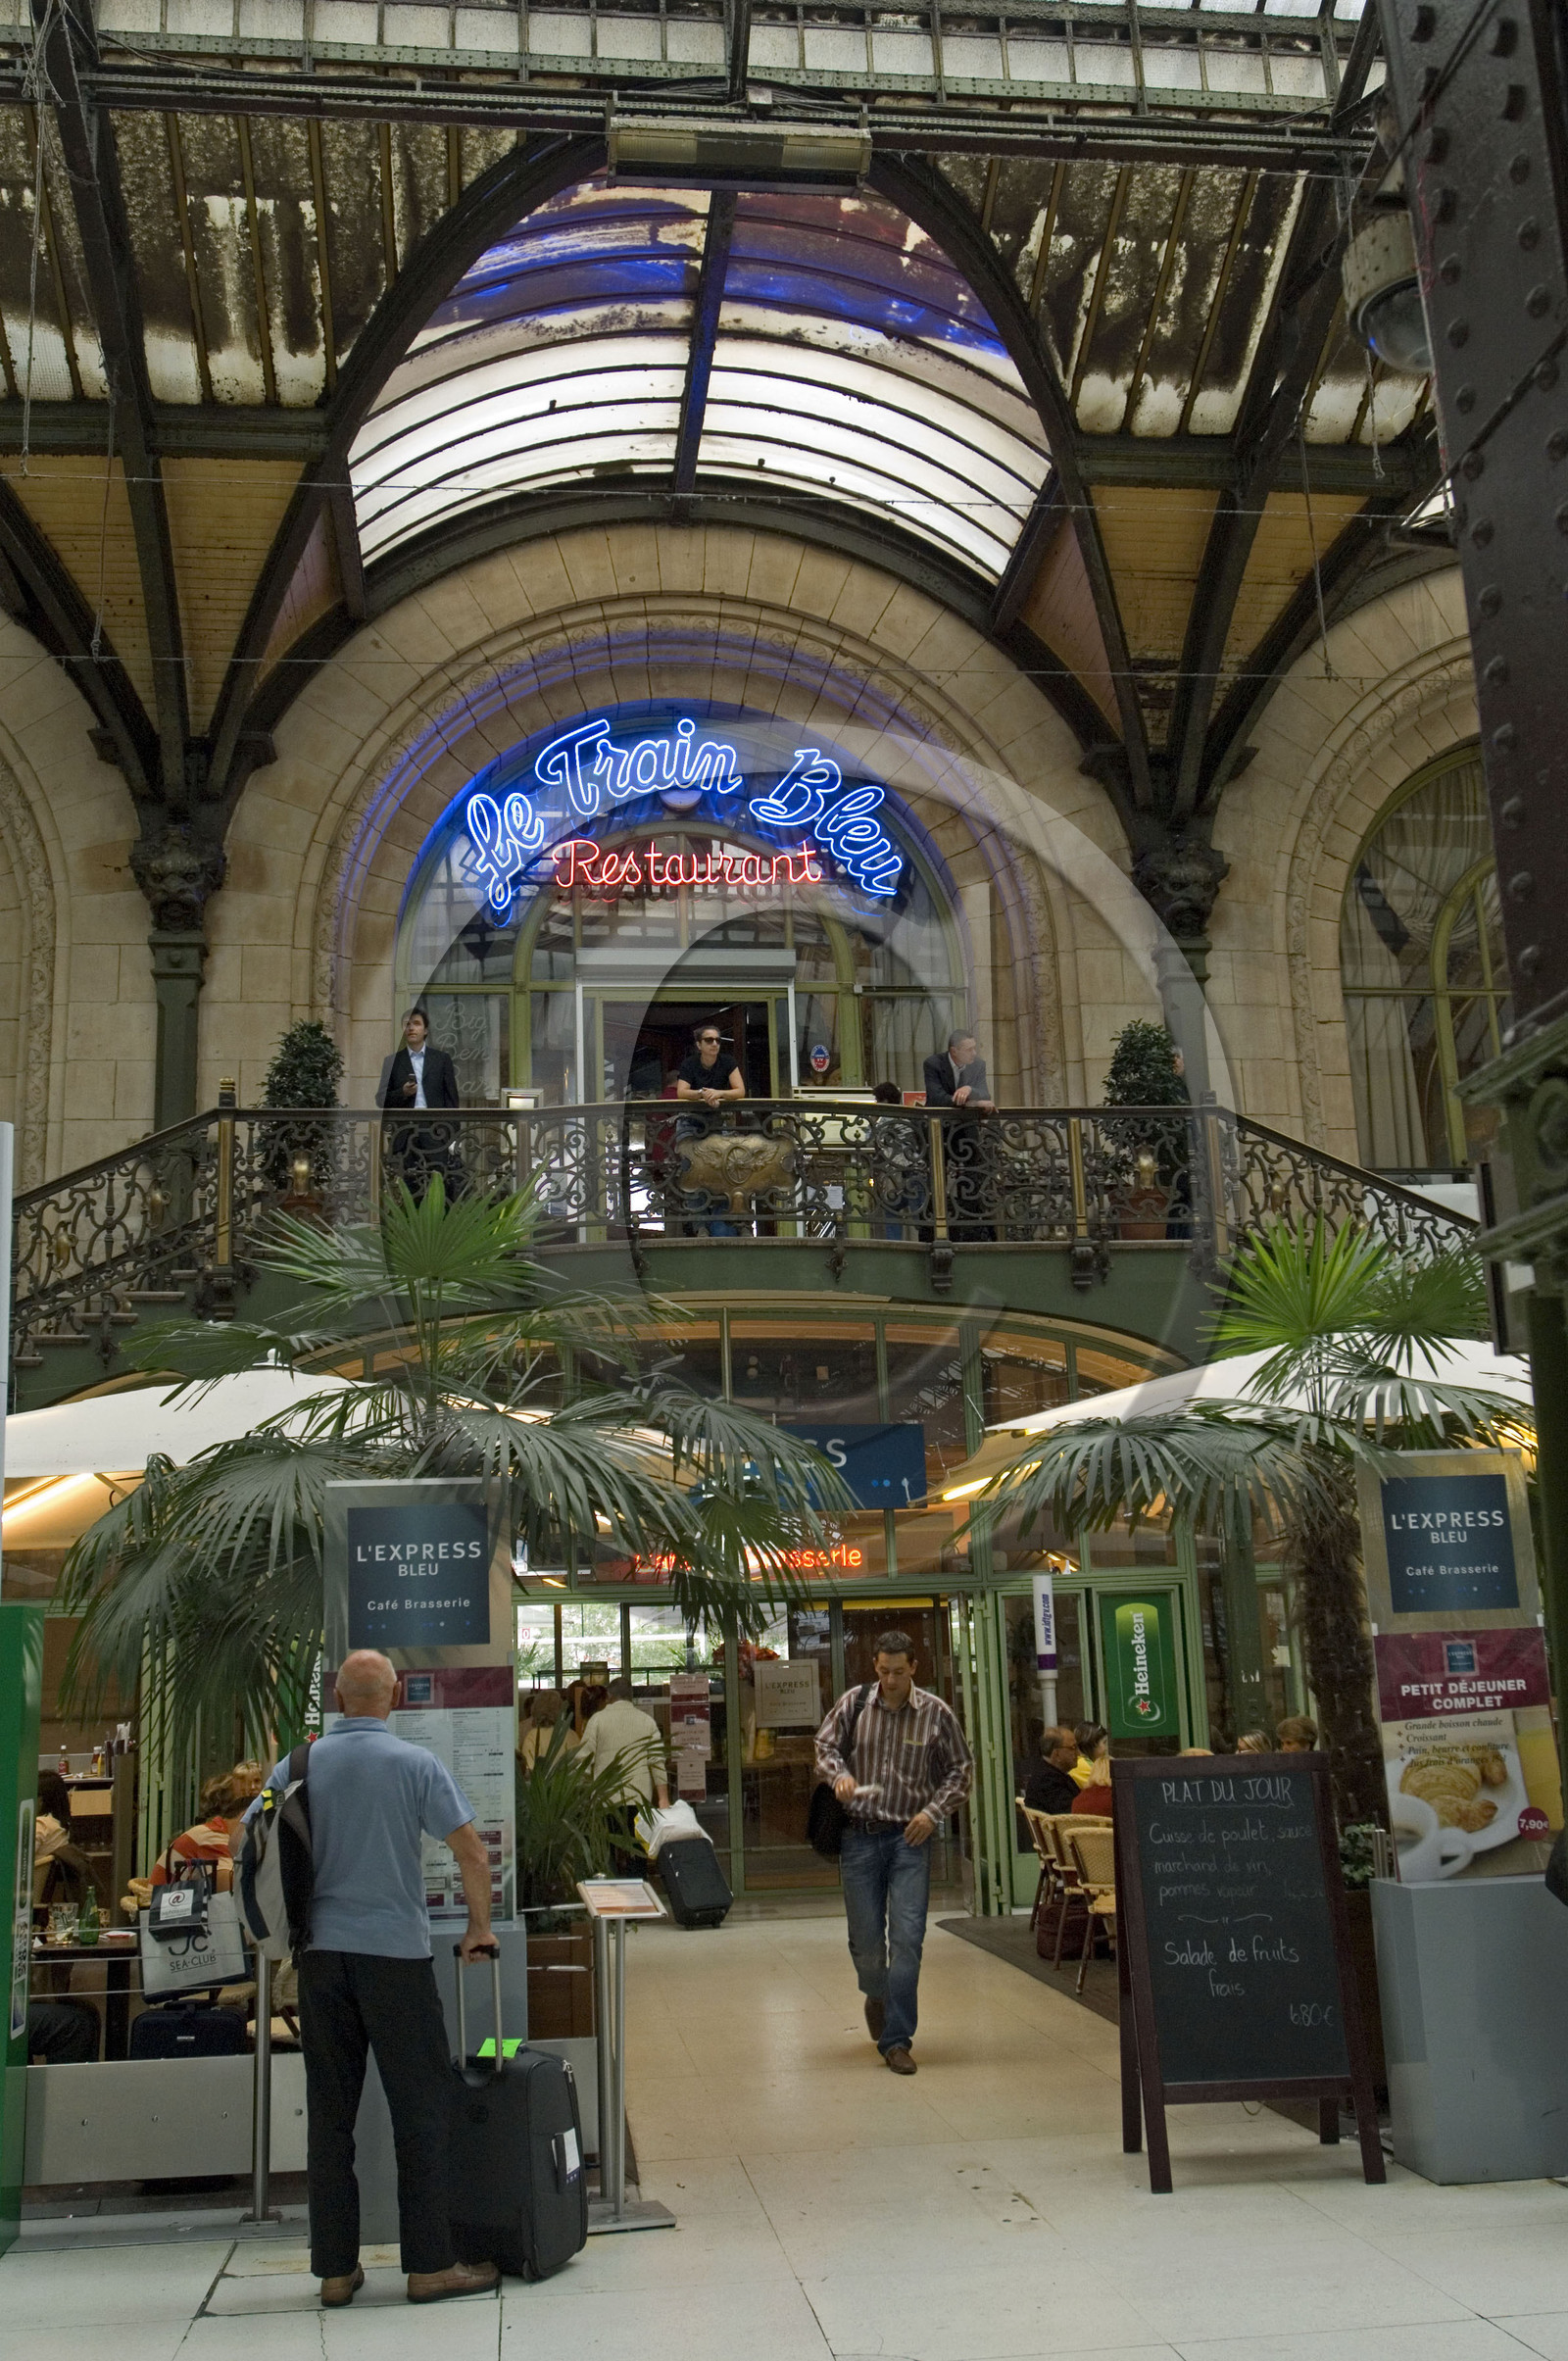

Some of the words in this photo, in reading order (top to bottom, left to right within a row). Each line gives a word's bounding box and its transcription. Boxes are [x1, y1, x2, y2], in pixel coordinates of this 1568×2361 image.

[466, 792, 545, 910] Le
[534, 717, 744, 815] Train
[749, 748, 904, 896] Bleu
[552, 839, 822, 889] Restaurant
[435, 1001, 487, 1041] Big
[436, 1032, 490, 1060] Ben
[1392, 1510, 1504, 1530] L'EXPRESS
[1430, 1531, 1467, 1544] BLEU
[357, 1541, 481, 1562] L'EXPRESS
[398, 1563, 439, 1577] BLEU
[1405, 1565, 1435, 1577] Café
[1439, 1563, 1499, 1575] Brasserie
[367, 1599, 399, 1611] Café
[405, 1598, 470, 1609] Brasserie
[1131, 1612, 1150, 1696] Heineken
[1400, 1683, 1444, 1697] PETIT
[1448, 1679, 1527, 1695] DÉJEUNER
[1432, 1696, 1503, 1710] COMPLET
[1404, 1721, 1437, 1731] Grande
[1439, 1719, 1470, 1729] boisson
[1472, 1717, 1503, 1727] chaude
[1406, 1733, 1447, 1744] Croissant
[1161, 1780, 1205, 1803] PLAT
[1210, 1778, 1236, 1802] DU
[1243, 1776, 1295, 1805] JOUR
[1149, 1822, 1193, 1845] Cuisse
[1198, 1819, 1216, 1844] de
[1154, 1851, 1218, 1874] marchand
[1158, 1883, 1211, 1906] pommes
[1163, 1939, 1217, 1966] Salade
[1228, 1937, 1249, 1962] de
[1251, 1934, 1299, 1963] fruits
[1208, 1967, 1246, 1997] frais
